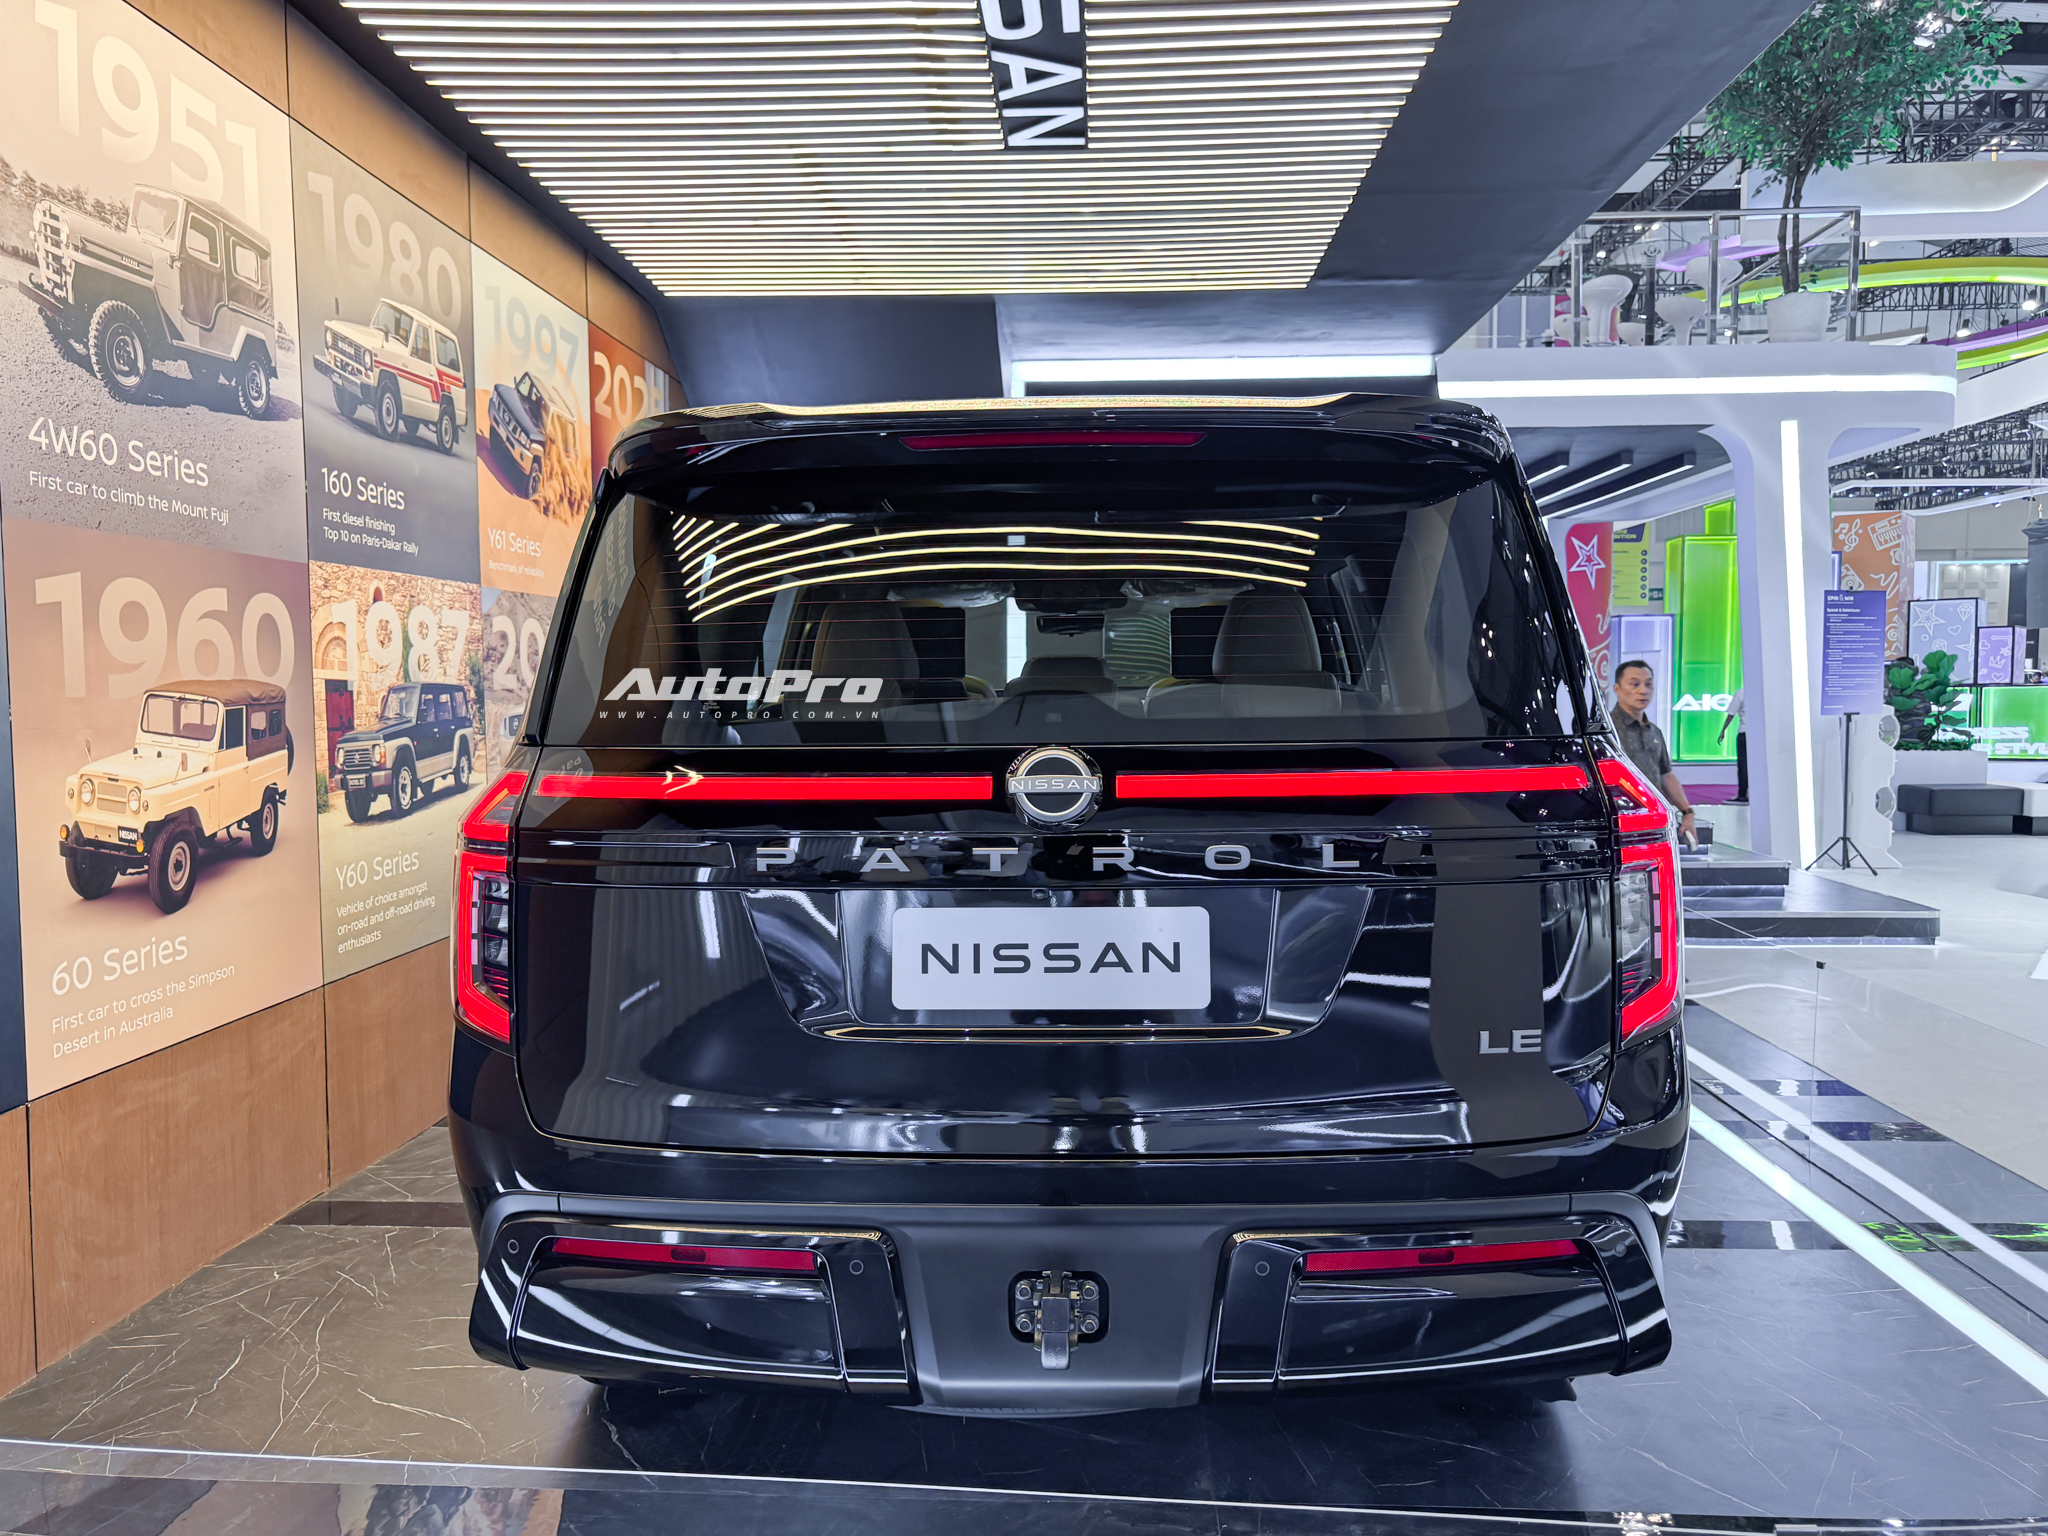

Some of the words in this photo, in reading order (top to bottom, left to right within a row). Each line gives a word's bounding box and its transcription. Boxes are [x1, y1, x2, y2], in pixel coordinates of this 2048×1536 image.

[35, 0, 260, 232] 1951
[307, 171, 462, 332] 1980
[485, 285, 580, 390] 1997
[28, 416, 118, 467] 4W60
[128, 440, 209, 487] Series
[29, 470, 62, 492] First
[66, 480, 89, 496] car
[92, 483, 107, 500] to
[110, 488, 145, 507] climb
[148, 495, 169, 512] the
[172, 500, 209, 520] Mount
[211, 507, 229, 526] Fuji
[321, 467, 352, 498] 160
[356, 476, 405, 510] Series
[322, 507, 341, 523] First
[342, 512, 364, 527] diesel
[365, 515, 396, 536] finishing
[323, 526, 339, 543] Top
[340, 530, 349, 542] 10
[350, 533, 361, 544] on
[362, 533, 402, 551] Paris-Dakar
[403, 541, 419, 557] Rally
[487, 527, 506, 550] Y61
[509, 532, 541, 558] Series
[488, 559, 517, 573] Benchmark
[518, 564, 524, 574] of
[35, 571, 295, 700] 1960
[331, 599, 470, 692] 1987
[1011, 778, 1098, 791] NISSAN
[119, 829, 138, 841] NISSAN
[335, 860, 368, 890] Y60
[373, 850, 419, 880] Series
[756, 844, 1361, 872] PATROL
[336, 901, 364, 918] Vehicle
[365, 896, 374, 909] of
[374, 891, 398, 906] choice
[398, 881, 428, 899] amongst
[337, 915, 368, 936] on-road
[369, 911, 384, 925] and
[385, 901, 413, 920] off-road
[413, 896, 436, 910] driving
[337, 930, 382, 954] enthusiasts
[921, 941, 1182, 975] NISSAN
[52, 955, 93, 996] 60
[103, 935, 188, 981] Series
[52, 1010, 84, 1034] First
[87, 1004, 110, 1022] car
[112, 999, 127, 1014] to
[130, 987, 163, 1008] cross
[166, 979, 186, 997] the
[188, 964, 235, 990] Simpson
[53, 1030, 100, 1058] Desert
[104, 1025, 116, 1041] in
[119, 1006, 174, 1035] Australia
[1479, 1029, 1542, 1054] LE
